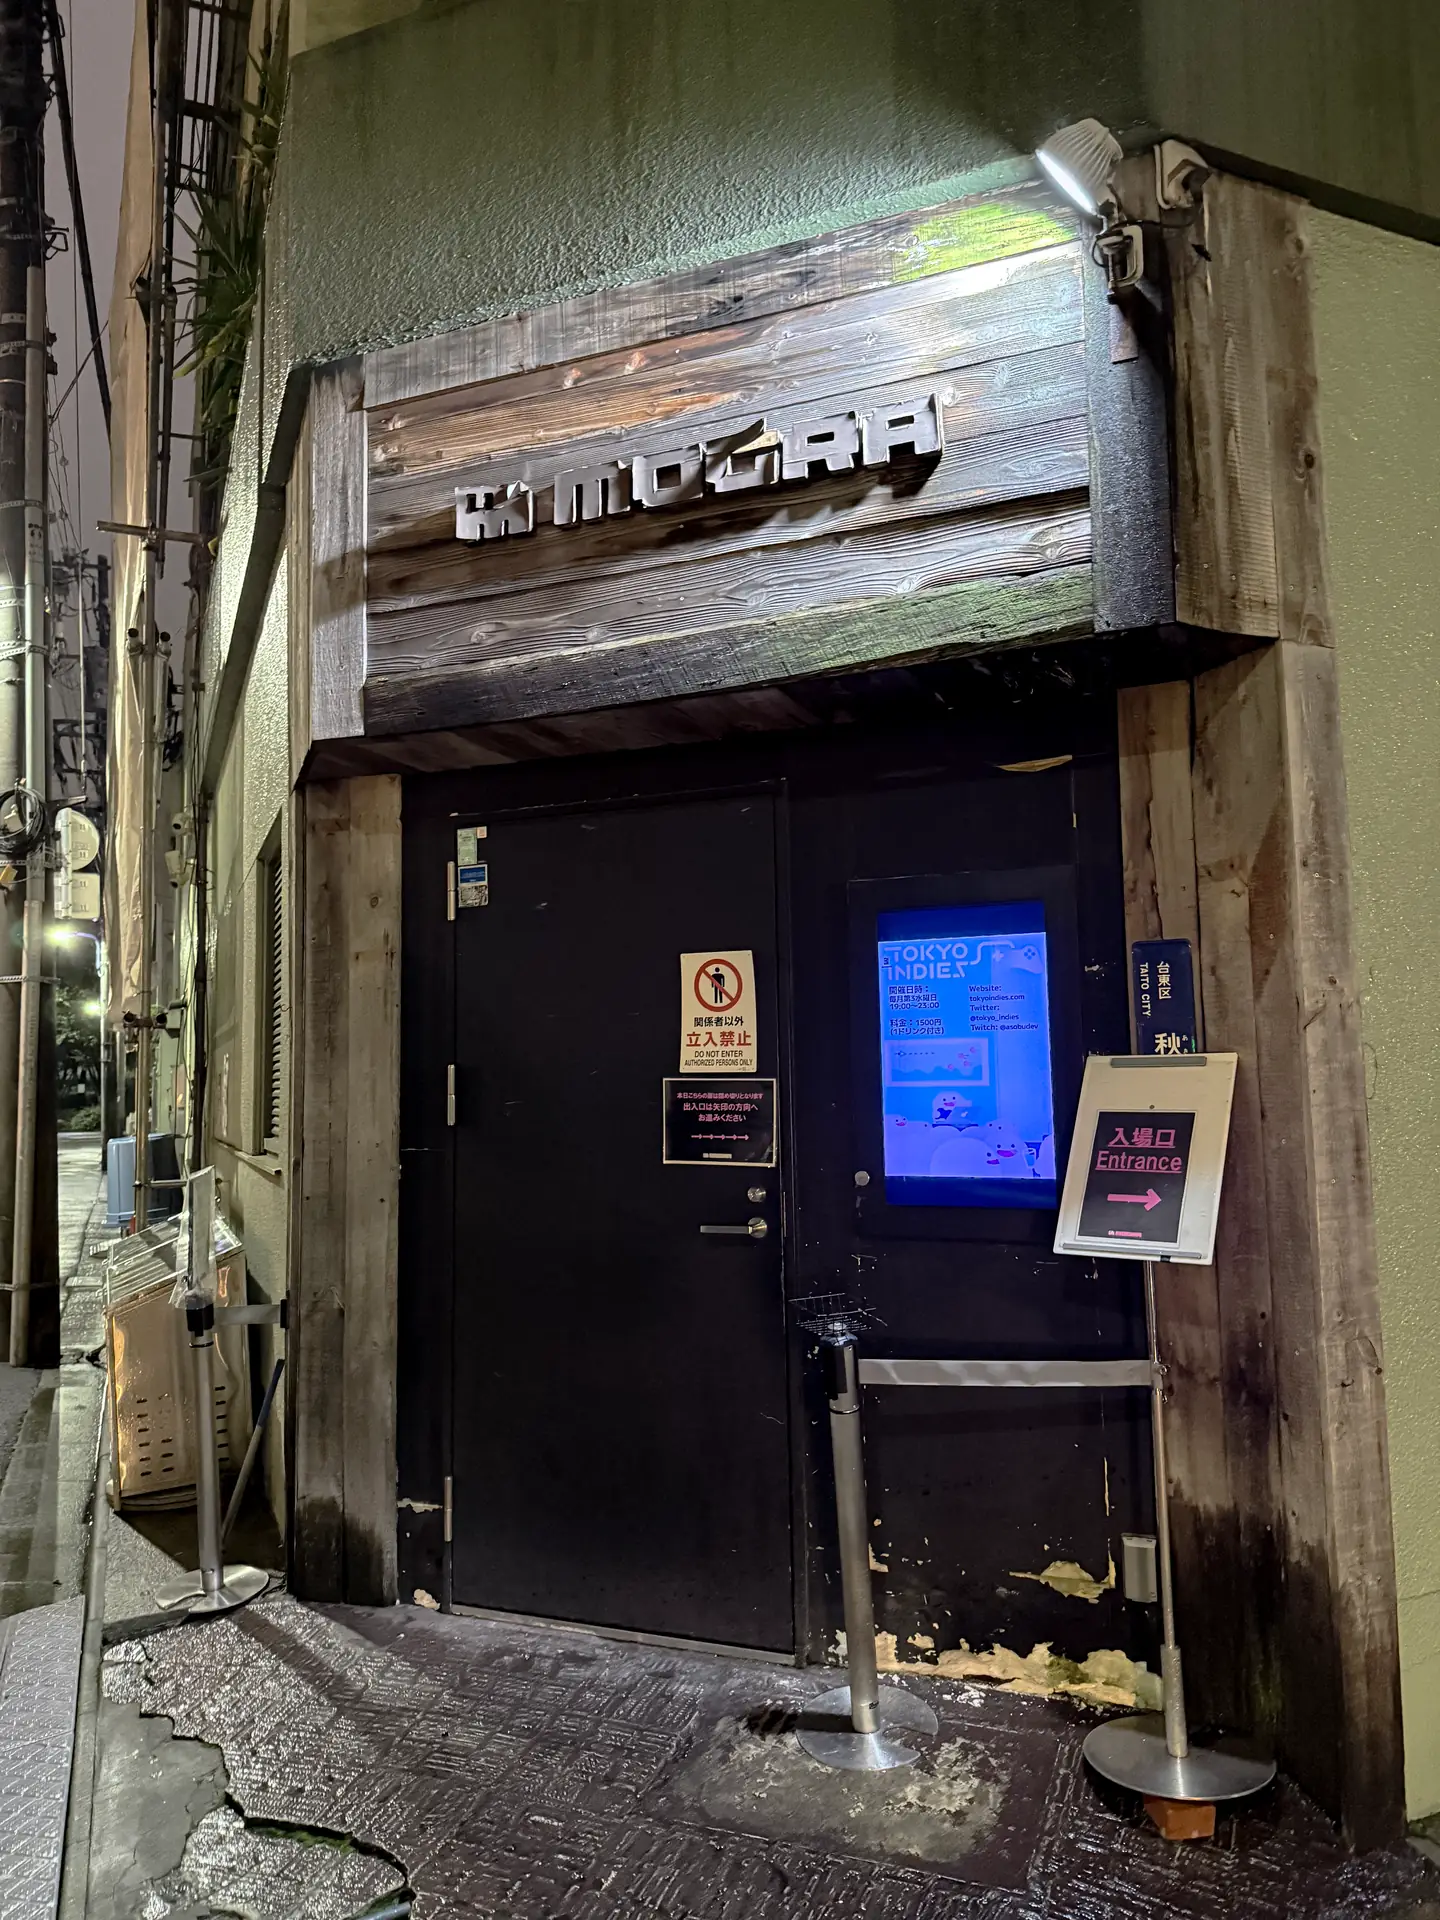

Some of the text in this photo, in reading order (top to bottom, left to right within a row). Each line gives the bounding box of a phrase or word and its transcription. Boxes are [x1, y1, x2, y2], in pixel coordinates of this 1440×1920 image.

[884, 943, 968, 963] TOKYO
[887, 961, 967, 981] INDIES
[1156, 961, 1172, 1000] 台東区
[969, 994, 1025, 1002] tokyoindies.com
[1139, 962, 1152, 1017] TAITO CITY
[694, 1016, 744, 1027] 関係者以外
[686, 1030, 752, 1047] 立入禁止
[1154, 1032, 1181, 1055] 秋
[683, 1102, 759, 1111] 出入口は矢印の方向へ
[698, 1113, 747, 1122] お進みください
[1107, 1127, 1176, 1148] 入場口
[1095, 1150, 1183, 1173] Entrance
